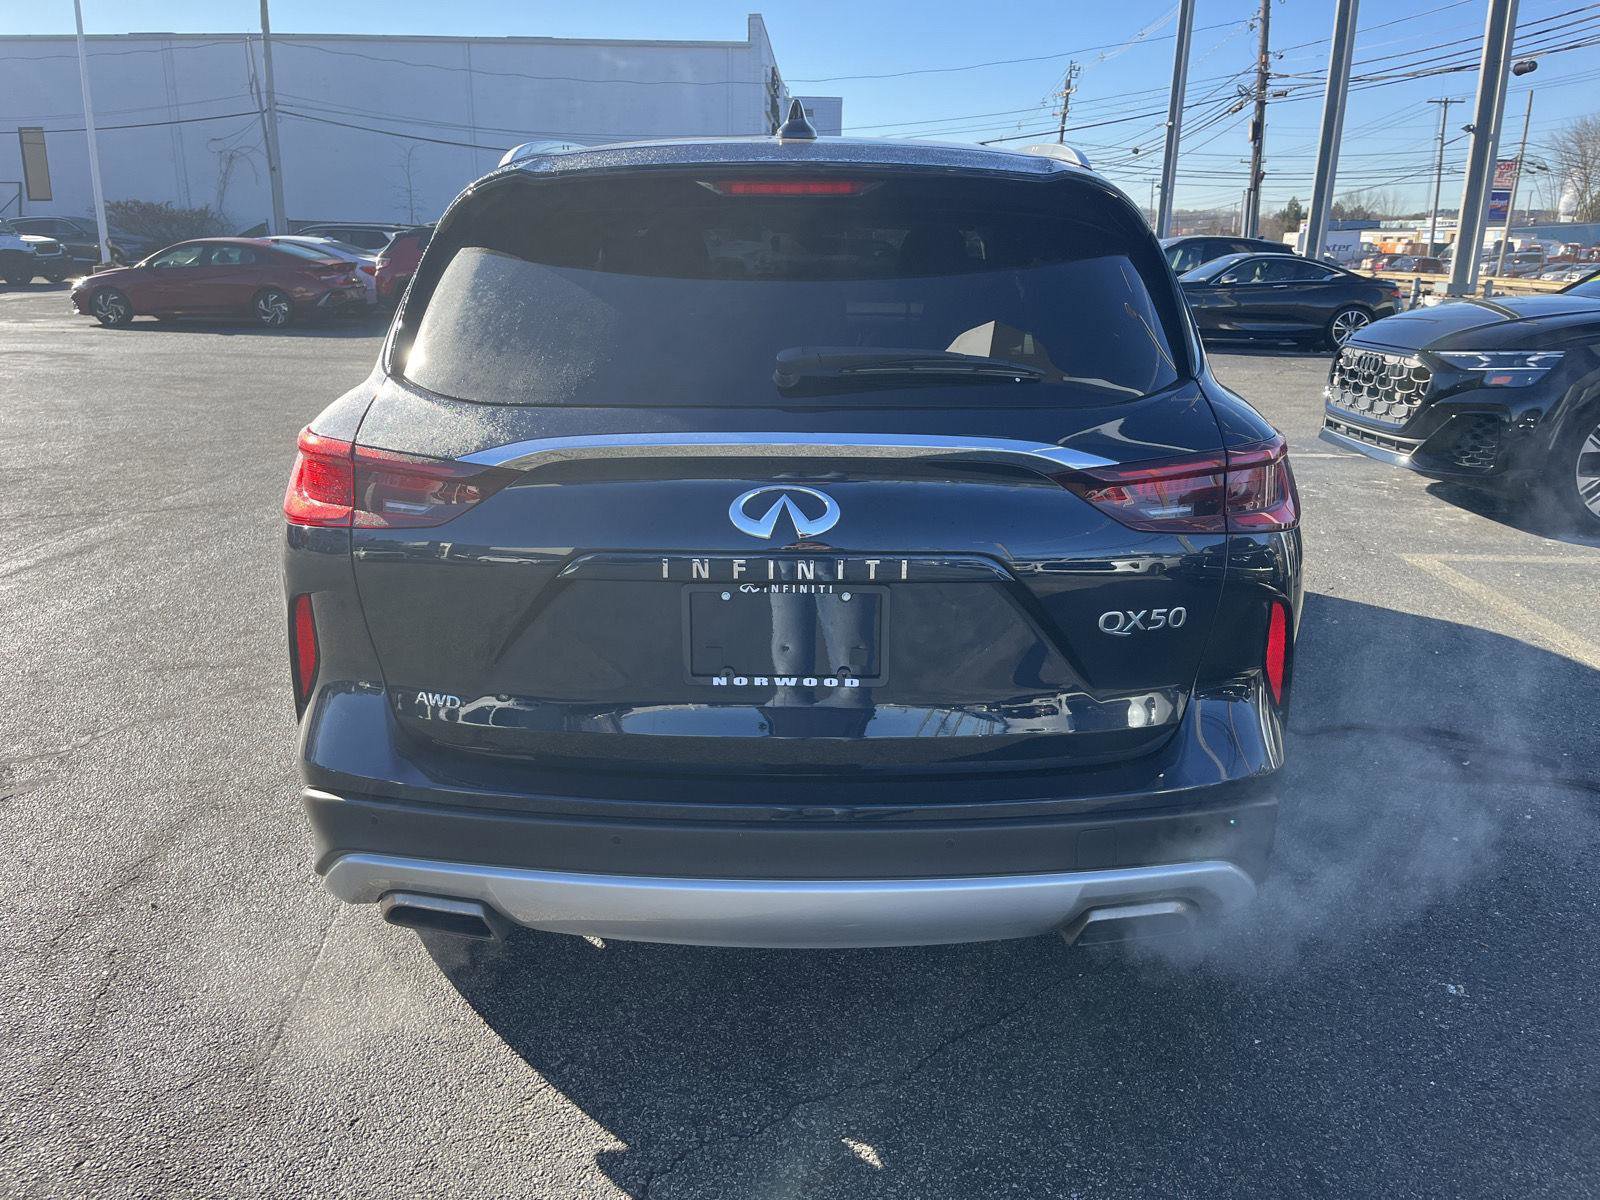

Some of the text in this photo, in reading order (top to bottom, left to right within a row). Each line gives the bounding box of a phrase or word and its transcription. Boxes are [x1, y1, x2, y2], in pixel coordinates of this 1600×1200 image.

[1325, 243, 1353, 252] xter
[661, 558, 908, 580] INFINITI
[763, 584, 834, 594] INFINITI
[1098, 606, 1188, 636] QX50
[712, 676, 860, 688] NORWOOD
[414, 691, 461, 709] AWD
